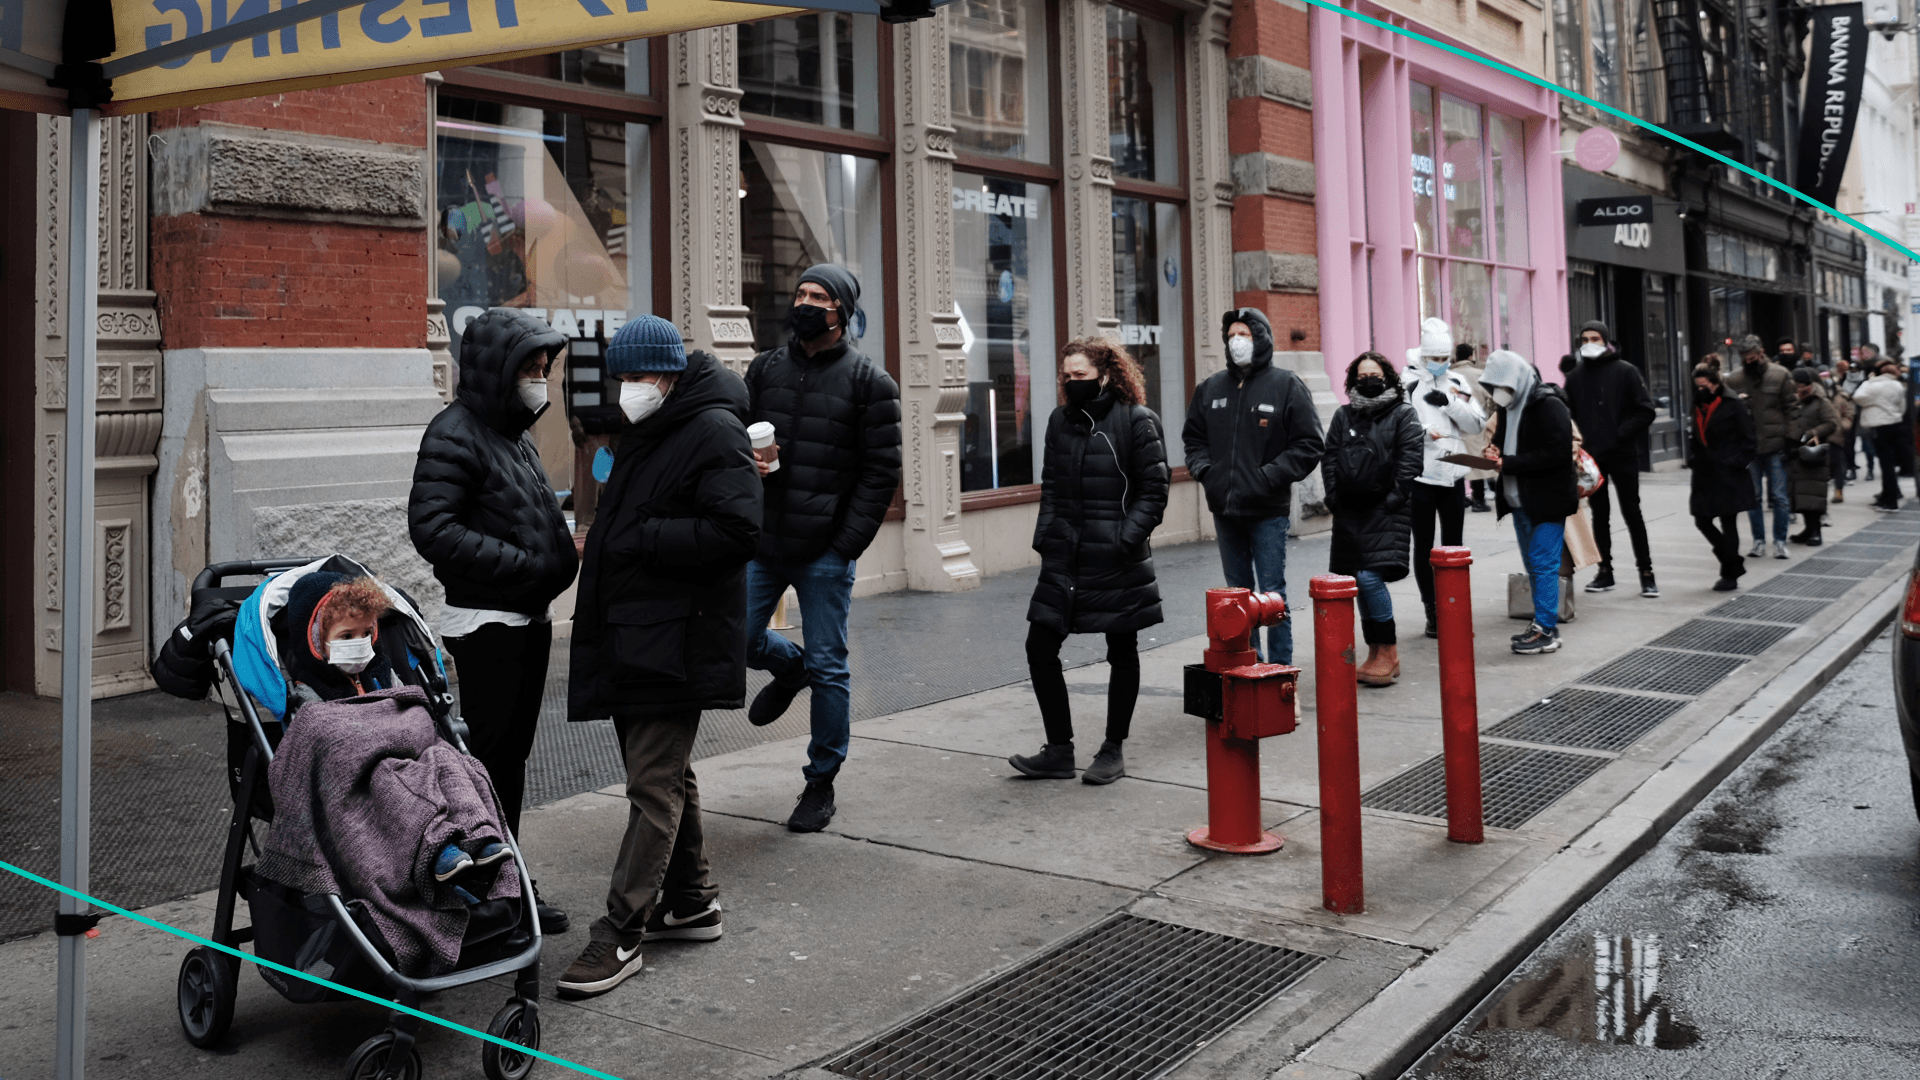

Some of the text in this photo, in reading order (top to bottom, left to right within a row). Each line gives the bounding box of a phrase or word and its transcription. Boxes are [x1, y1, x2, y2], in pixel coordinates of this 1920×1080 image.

[1816, 16, 1851, 187] BANANA REPUB
[952, 186, 1038, 219] CREATE
[1593, 204, 1643, 217] ALDO
[1613, 222, 1651, 248] ALDO
[453, 306, 627, 338] CATE
